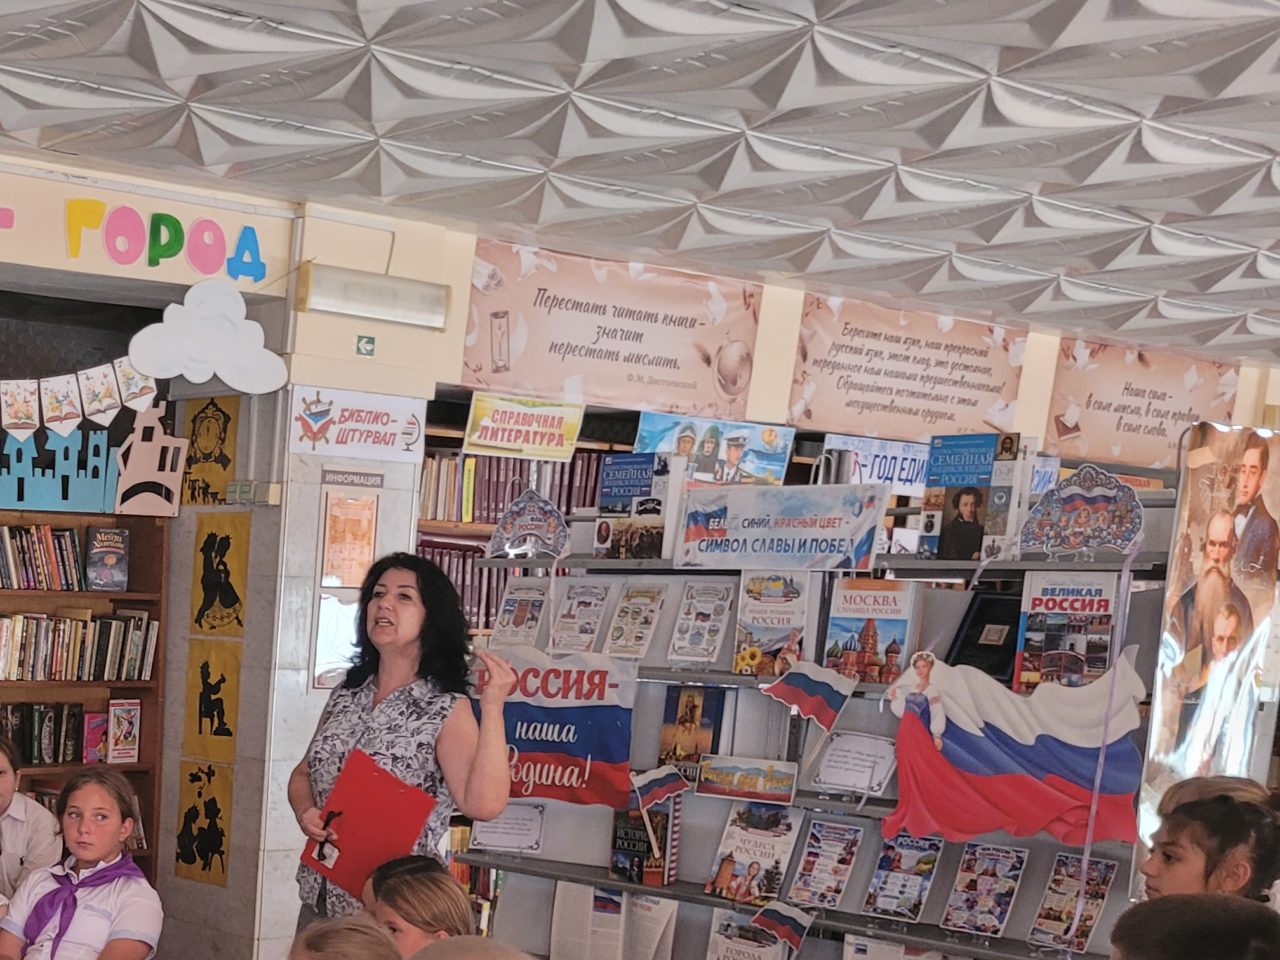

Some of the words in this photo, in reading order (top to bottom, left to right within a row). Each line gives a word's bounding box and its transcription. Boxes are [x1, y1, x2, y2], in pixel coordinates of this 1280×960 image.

[65, 198, 266, 283] ГОРОД
[533, 287, 607, 316] Перестать
[612, 305, 658, 325] читать
[661, 314, 696, 329] книги
[591, 323, 644, 345] значит
[548, 340, 620, 363] перестать
[623, 353, 680, 371] мыслить.
[491, 409, 564, 430] СПРАВОЧНАЯ
[478, 425, 565, 448] ЛИТЕРАТУРА
[325, 472, 382, 487] ИНФОРМАЦИЯ
[869, 454, 897, 484] ГОД
[819, 517, 843, 530] ЦВЕТ
[697, 538, 748, 553] СИМВОЛ
[751, 538, 795, 553] СЛАВЫ
[797, 539, 807, 553] И
[842, 594, 898, 607] МОСКВА
[1041, 587, 1103, 597] ВЕЛИКАЯ
[1031, 597, 1109, 613] РОССИЯ
[516, 720, 578, 743] наша
